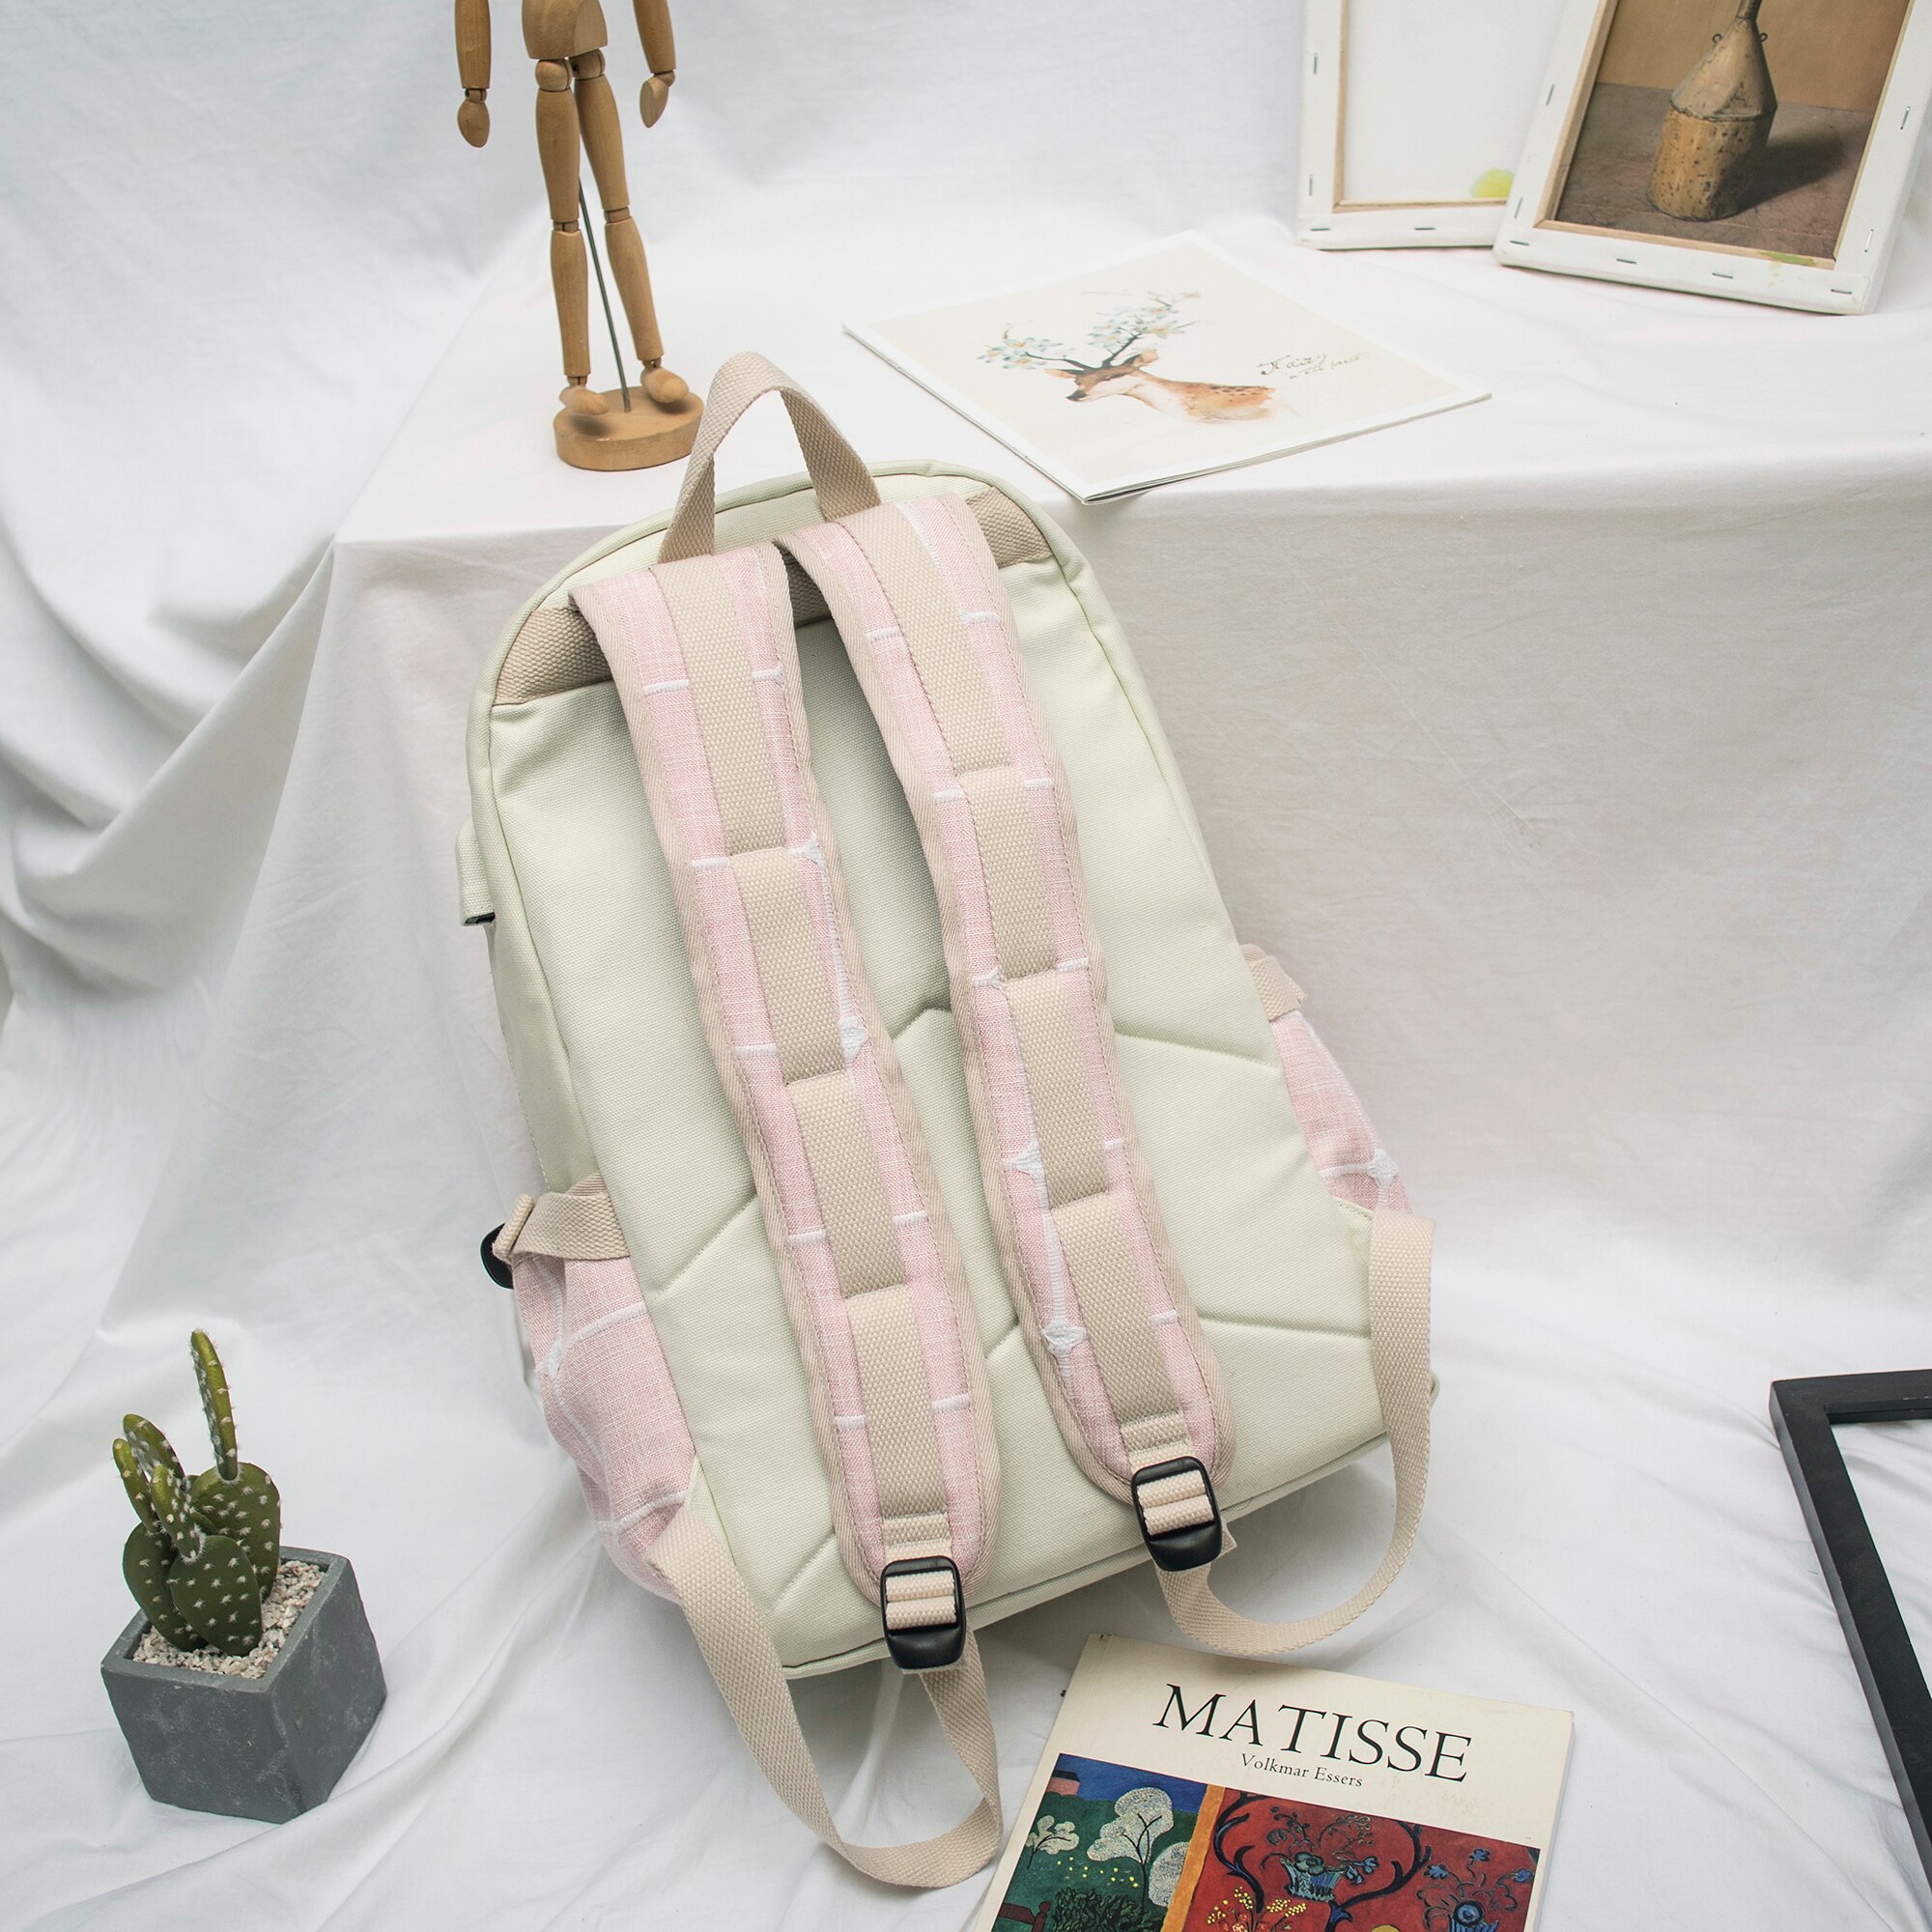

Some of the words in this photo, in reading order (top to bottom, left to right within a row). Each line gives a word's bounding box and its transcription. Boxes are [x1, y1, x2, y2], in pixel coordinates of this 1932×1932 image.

[1152, 1683, 1473, 1782] MATISSE
[1240, 1752, 1310, 1778] Volkmar
[1314, 1767, 1363, 1788] Essers
